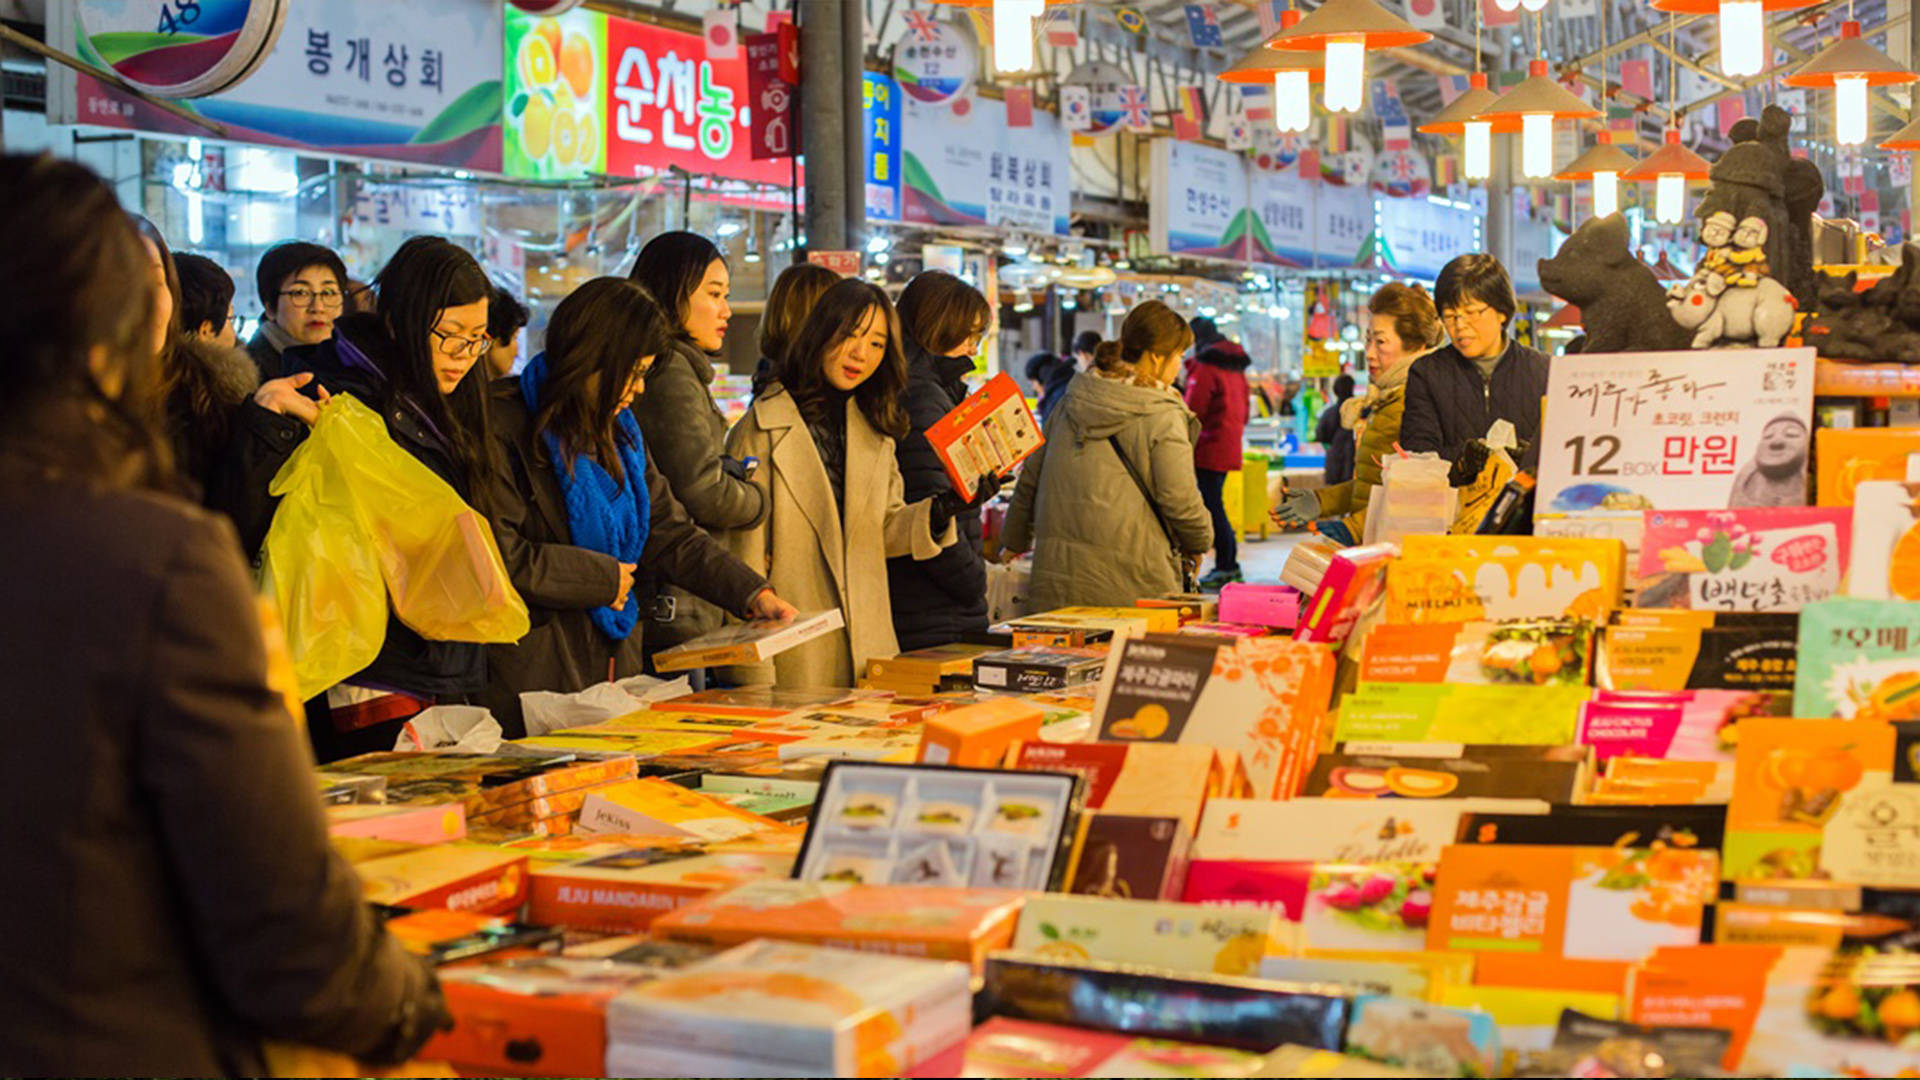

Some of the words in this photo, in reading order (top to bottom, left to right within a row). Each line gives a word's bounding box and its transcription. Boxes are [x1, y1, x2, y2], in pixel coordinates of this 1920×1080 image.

[614, 46, 751, 159] 순천농
[1564, 435, 1622, 476] 12
[1623, 463, 1659, 476] BOX
[1662, 435, 1738, 475] 만원
